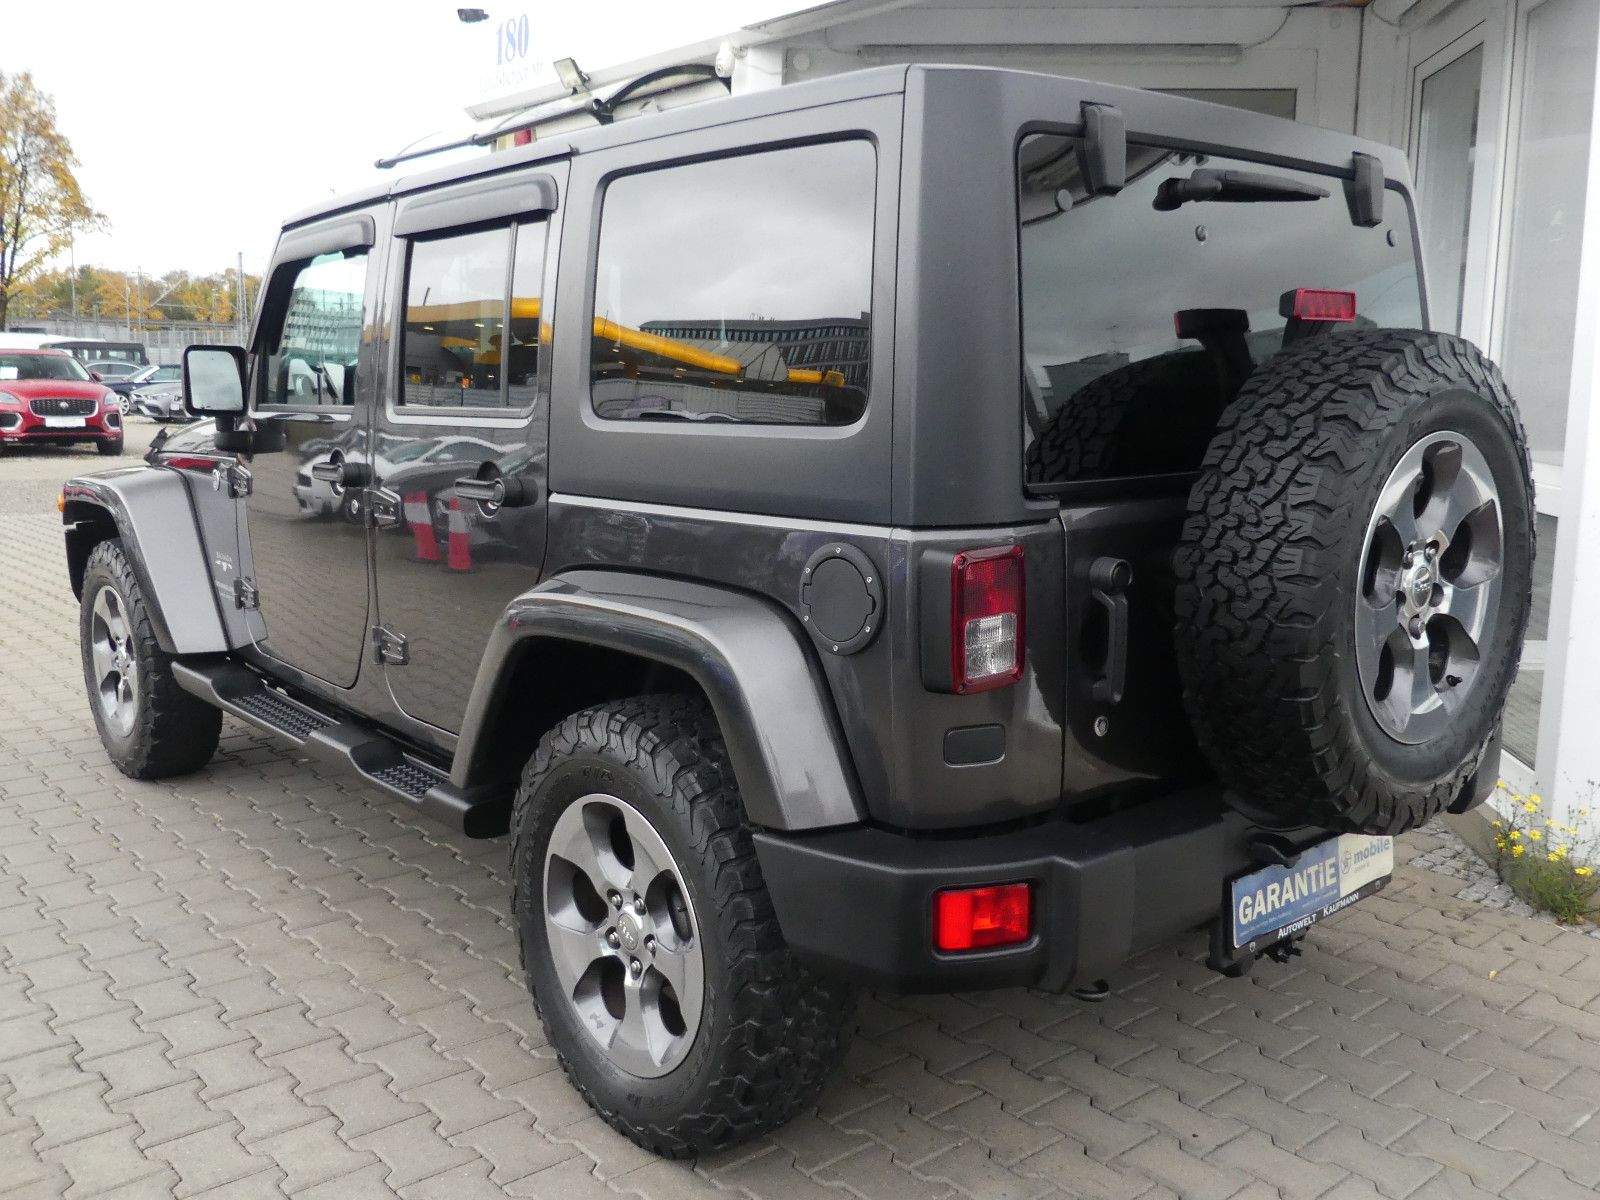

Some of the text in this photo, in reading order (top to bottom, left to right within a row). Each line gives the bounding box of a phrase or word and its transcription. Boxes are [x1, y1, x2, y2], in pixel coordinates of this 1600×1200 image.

[496, 14, 529, 65] 180
[1354, 838, 1391, 864] mobile
[1238, 857, 1337, 925] GARANTIE
[1277, 914, 1317, 938] AUTOWELT
